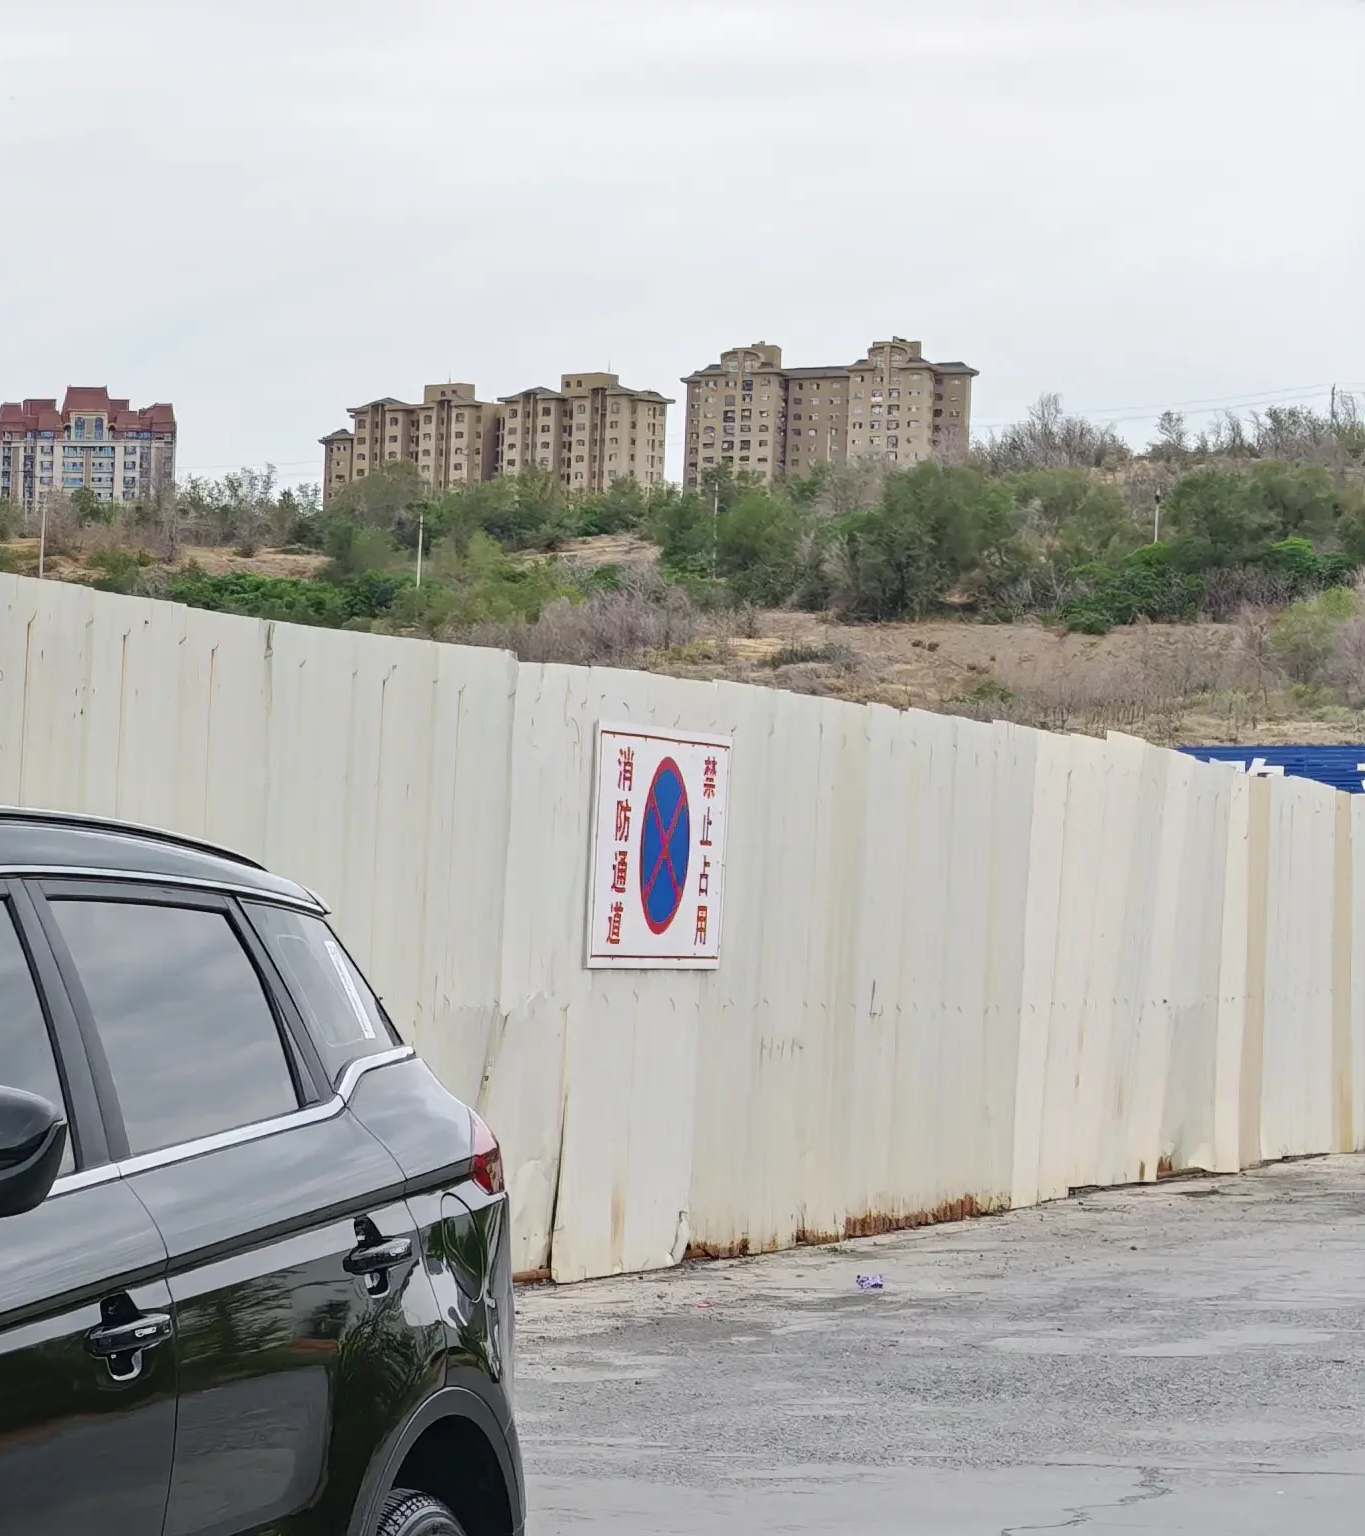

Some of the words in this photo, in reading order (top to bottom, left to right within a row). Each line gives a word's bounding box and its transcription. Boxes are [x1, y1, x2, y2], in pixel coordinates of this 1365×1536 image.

[606, 746, 635, 945] 消防通道
[693, 755, 718, 946] 禁止占用
